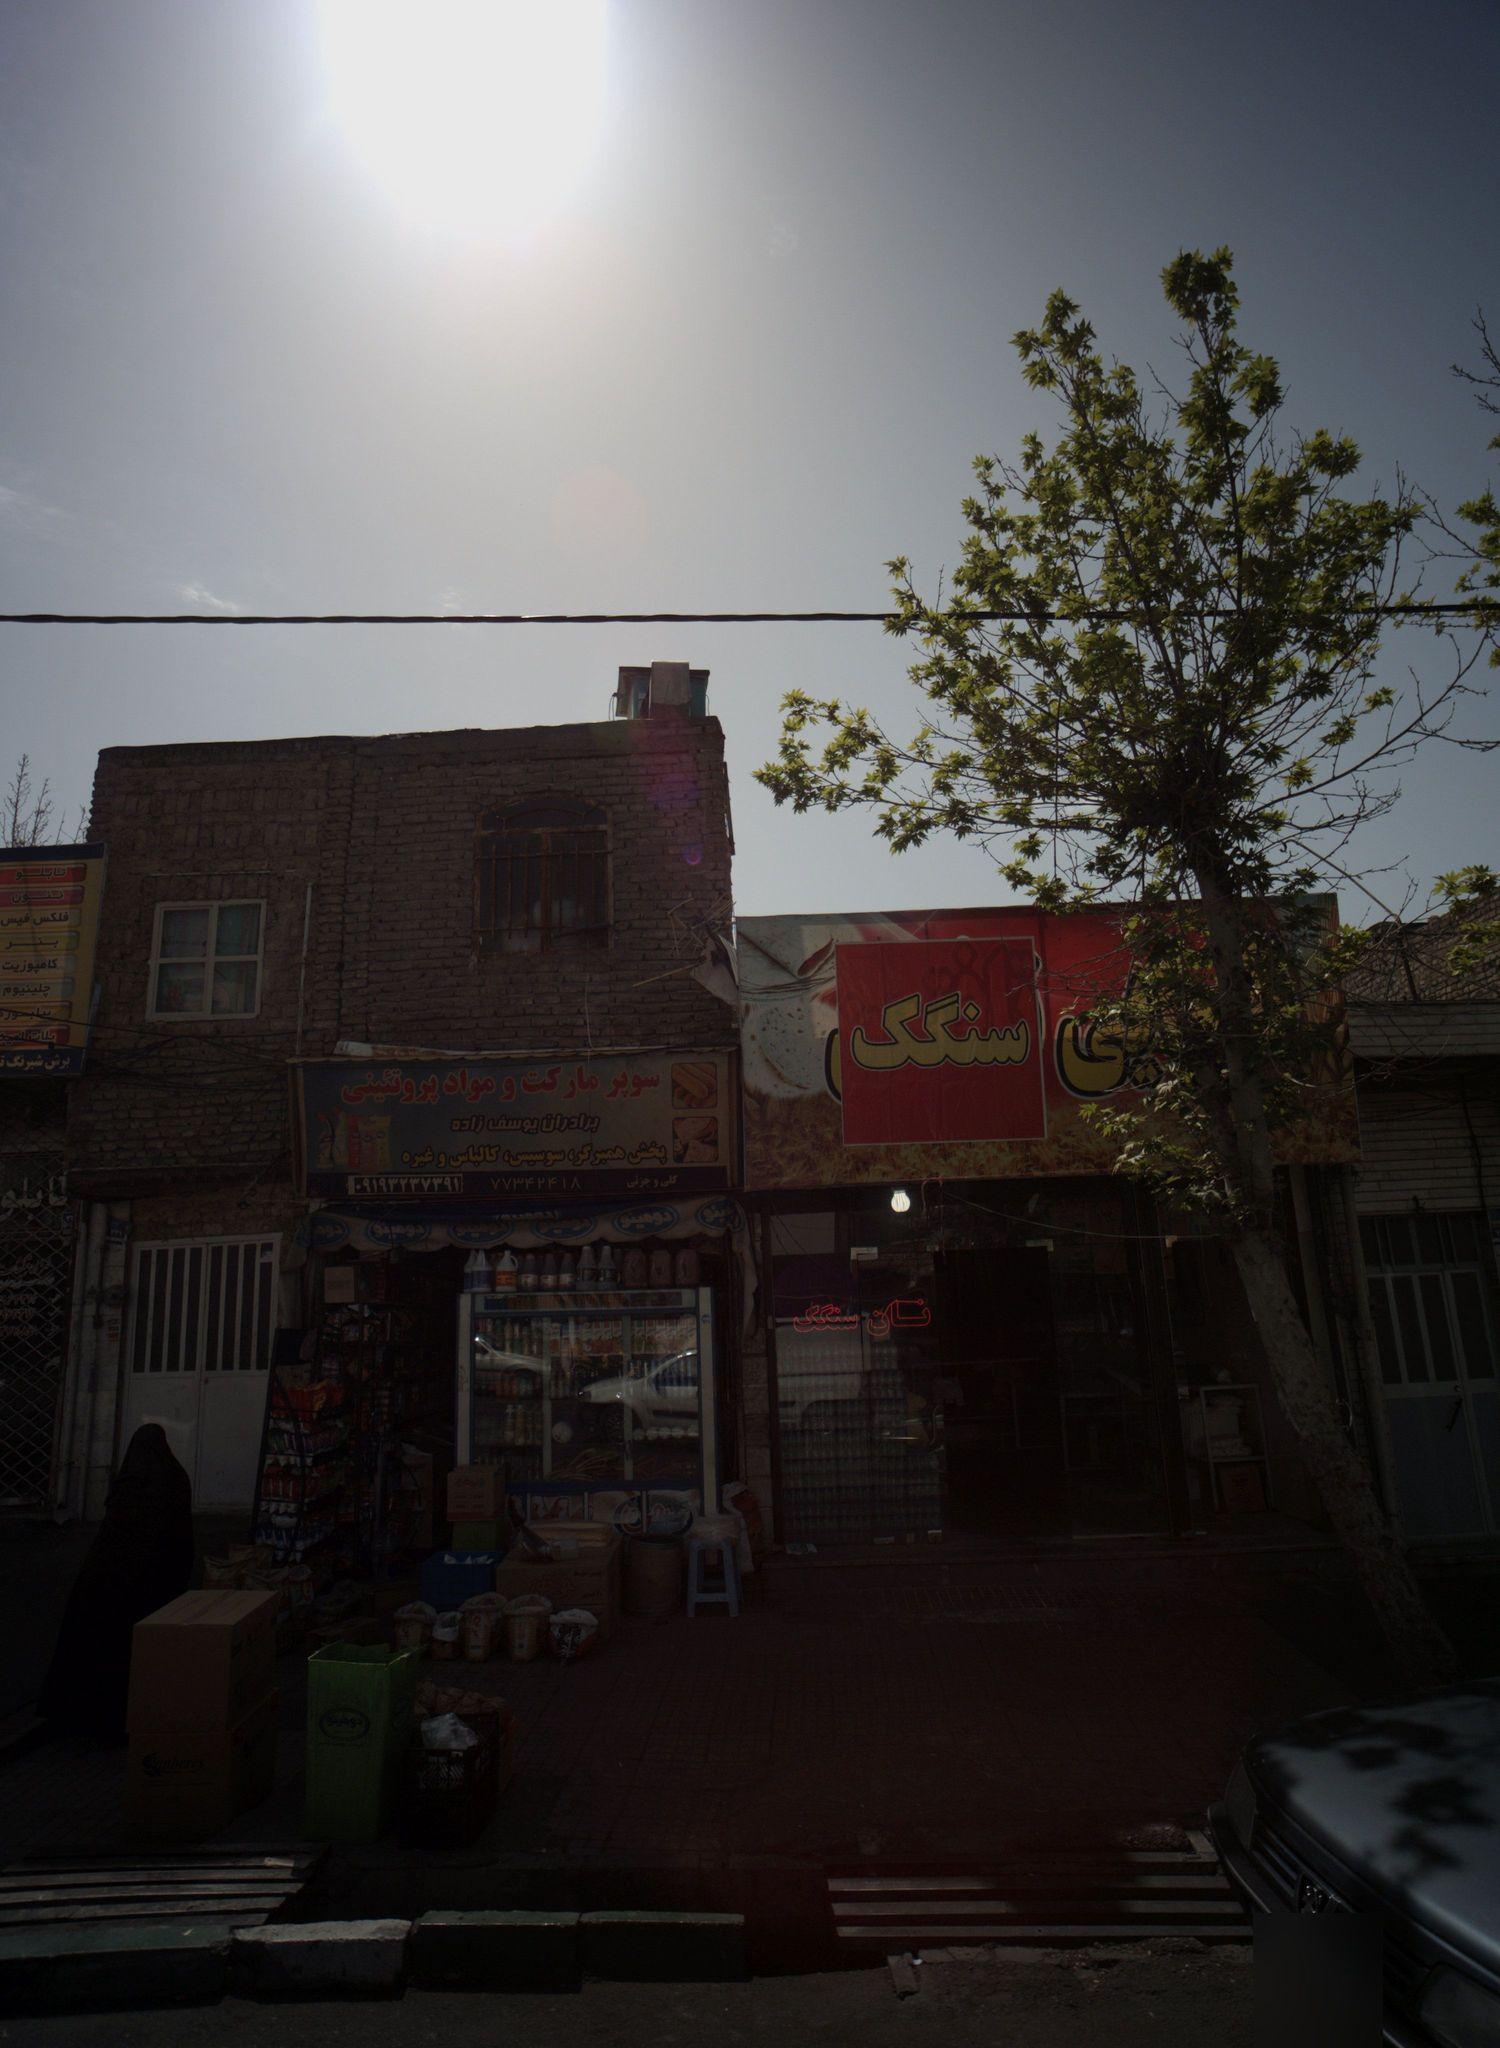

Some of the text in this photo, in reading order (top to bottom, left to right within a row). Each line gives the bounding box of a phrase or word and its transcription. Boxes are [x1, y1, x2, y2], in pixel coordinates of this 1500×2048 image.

[16, 864, 66, 881] تابلو
[33, 911, 70, 926] فلکس
[5, 937, 59, 950] بنر
[850, 992, 1030, 1071] سنگک
[340, 1065, 662, 1105] سوپر مارکت و مواد پروتئینی
[450, 1113, 601, 1135] برادران یوسف زاده
[401, 1146, 436, 1169] غیره
[437, 1152, 448, 1169] و
[448, 1144, 501, 1168] کالباس
[627, 1141, 669, 1164] پخش
[660, 1174, 680, 1188] کلی
[793, 1302, 860, 1334] سنگک
